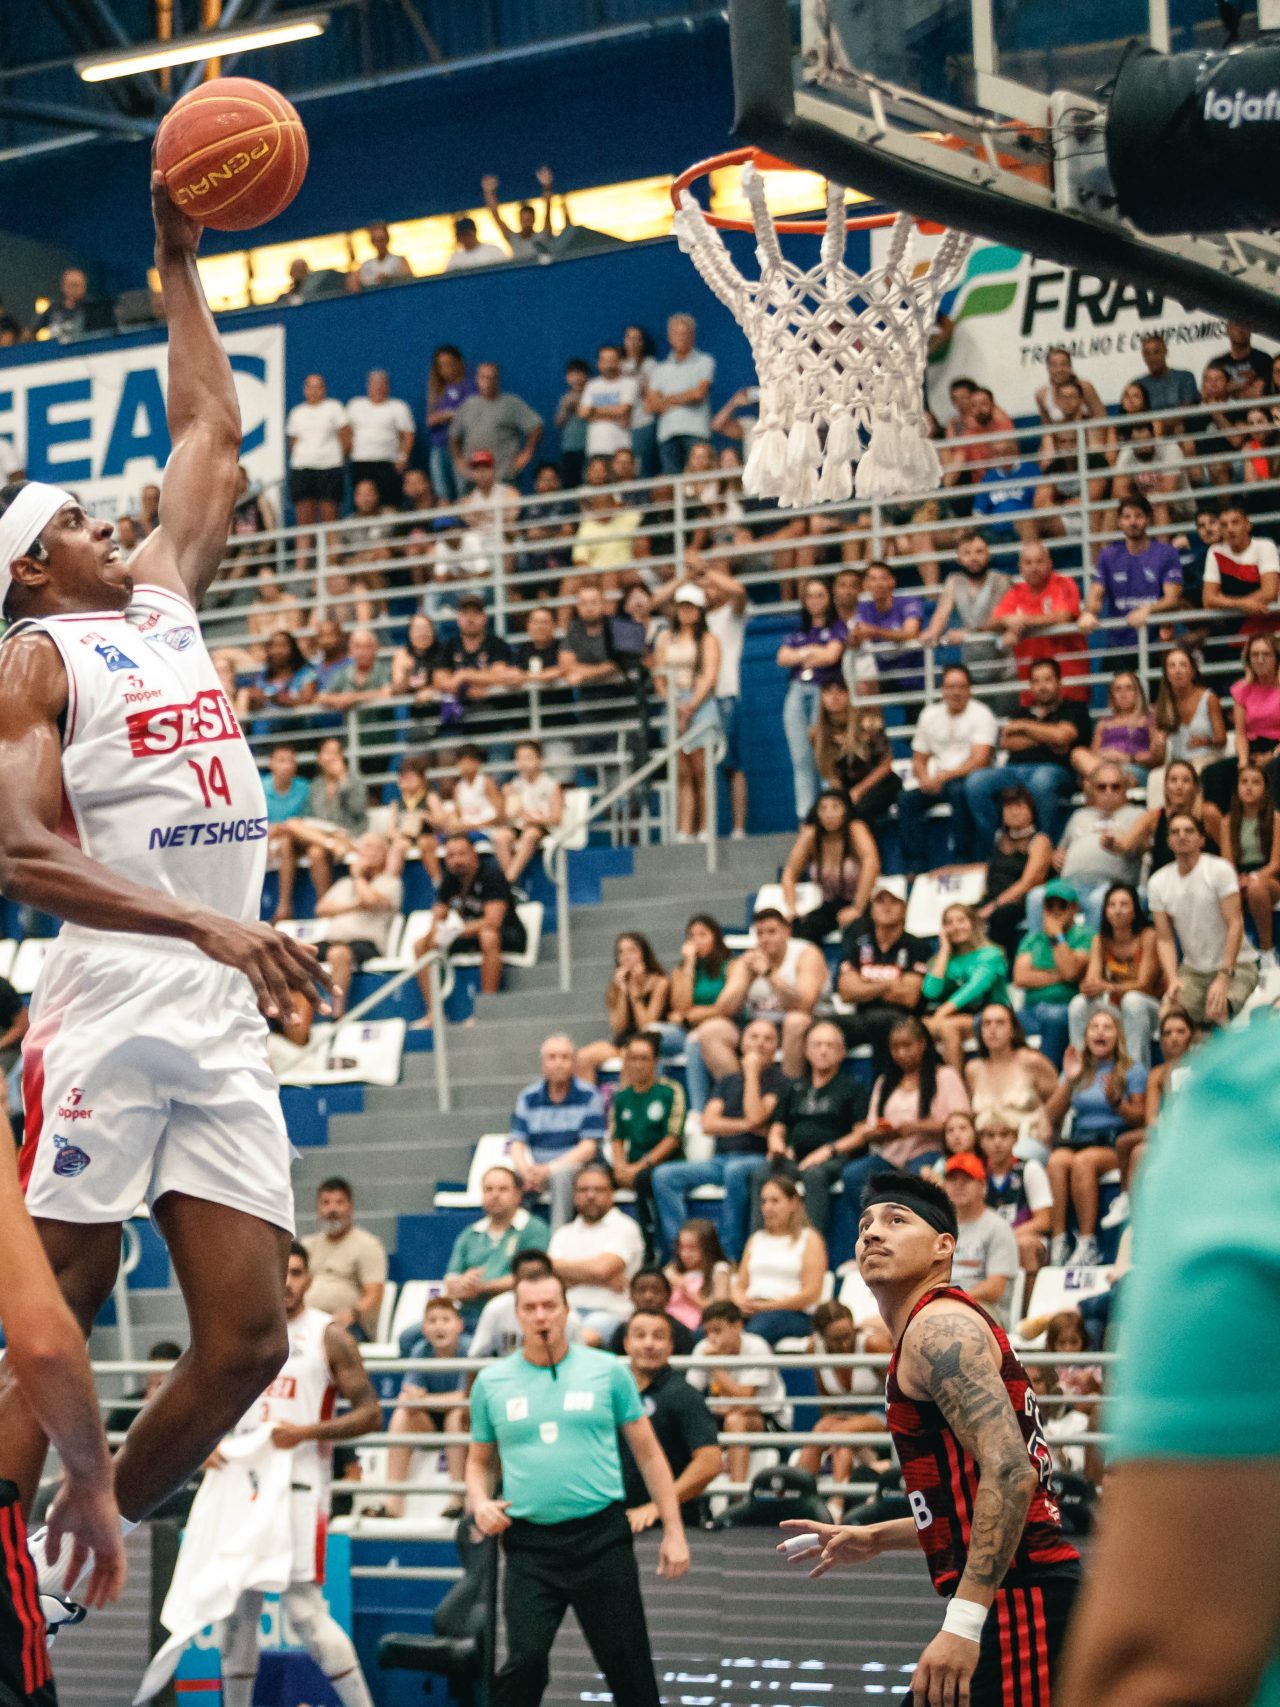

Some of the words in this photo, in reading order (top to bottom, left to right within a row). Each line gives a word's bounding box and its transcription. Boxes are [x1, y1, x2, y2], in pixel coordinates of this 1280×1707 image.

[1203, 88, 1280, 130] lojaf
[1020, 336, 1113, 366] TRALHO
[123, 688, 164, 705] Topper
[143, 696, 235, 752] SESI
[187, 755, 233, 809] 14
[148, 817, 268, 850] NETSHOES
[58, 1105, 95, 1122] opper
